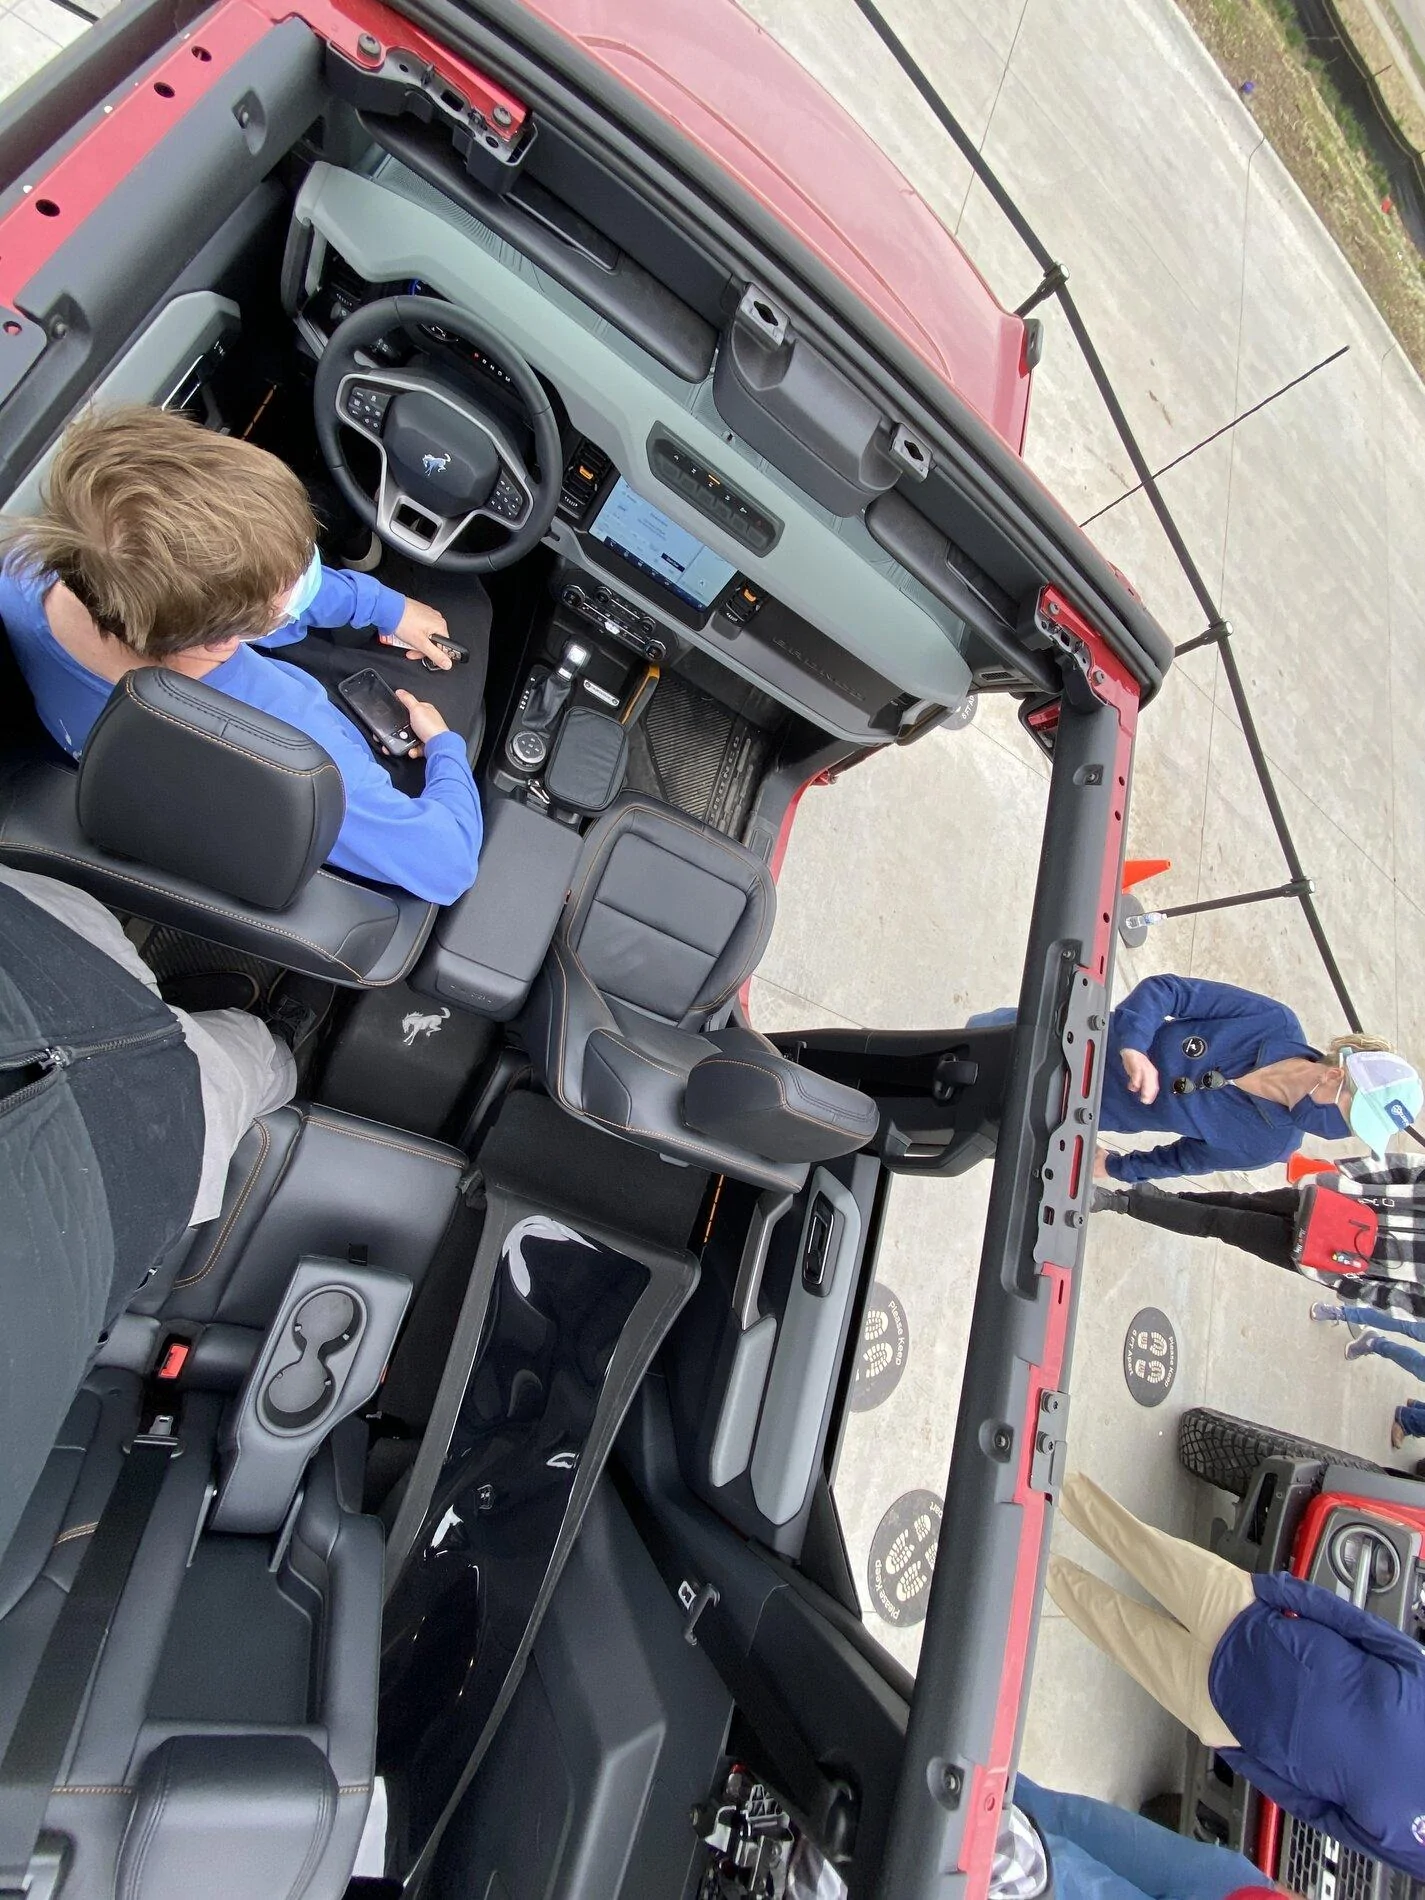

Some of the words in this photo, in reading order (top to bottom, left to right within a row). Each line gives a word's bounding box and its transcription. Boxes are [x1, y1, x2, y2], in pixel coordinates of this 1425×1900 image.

[887, 1300, 903, 1336] Please
[895, 1337, 905, 1366] Keep
[1164, 1366, 1175, 1388] Keep
[875, 1559, 883, 1592] Keep
[879, 1590, 901, 1620] Please
